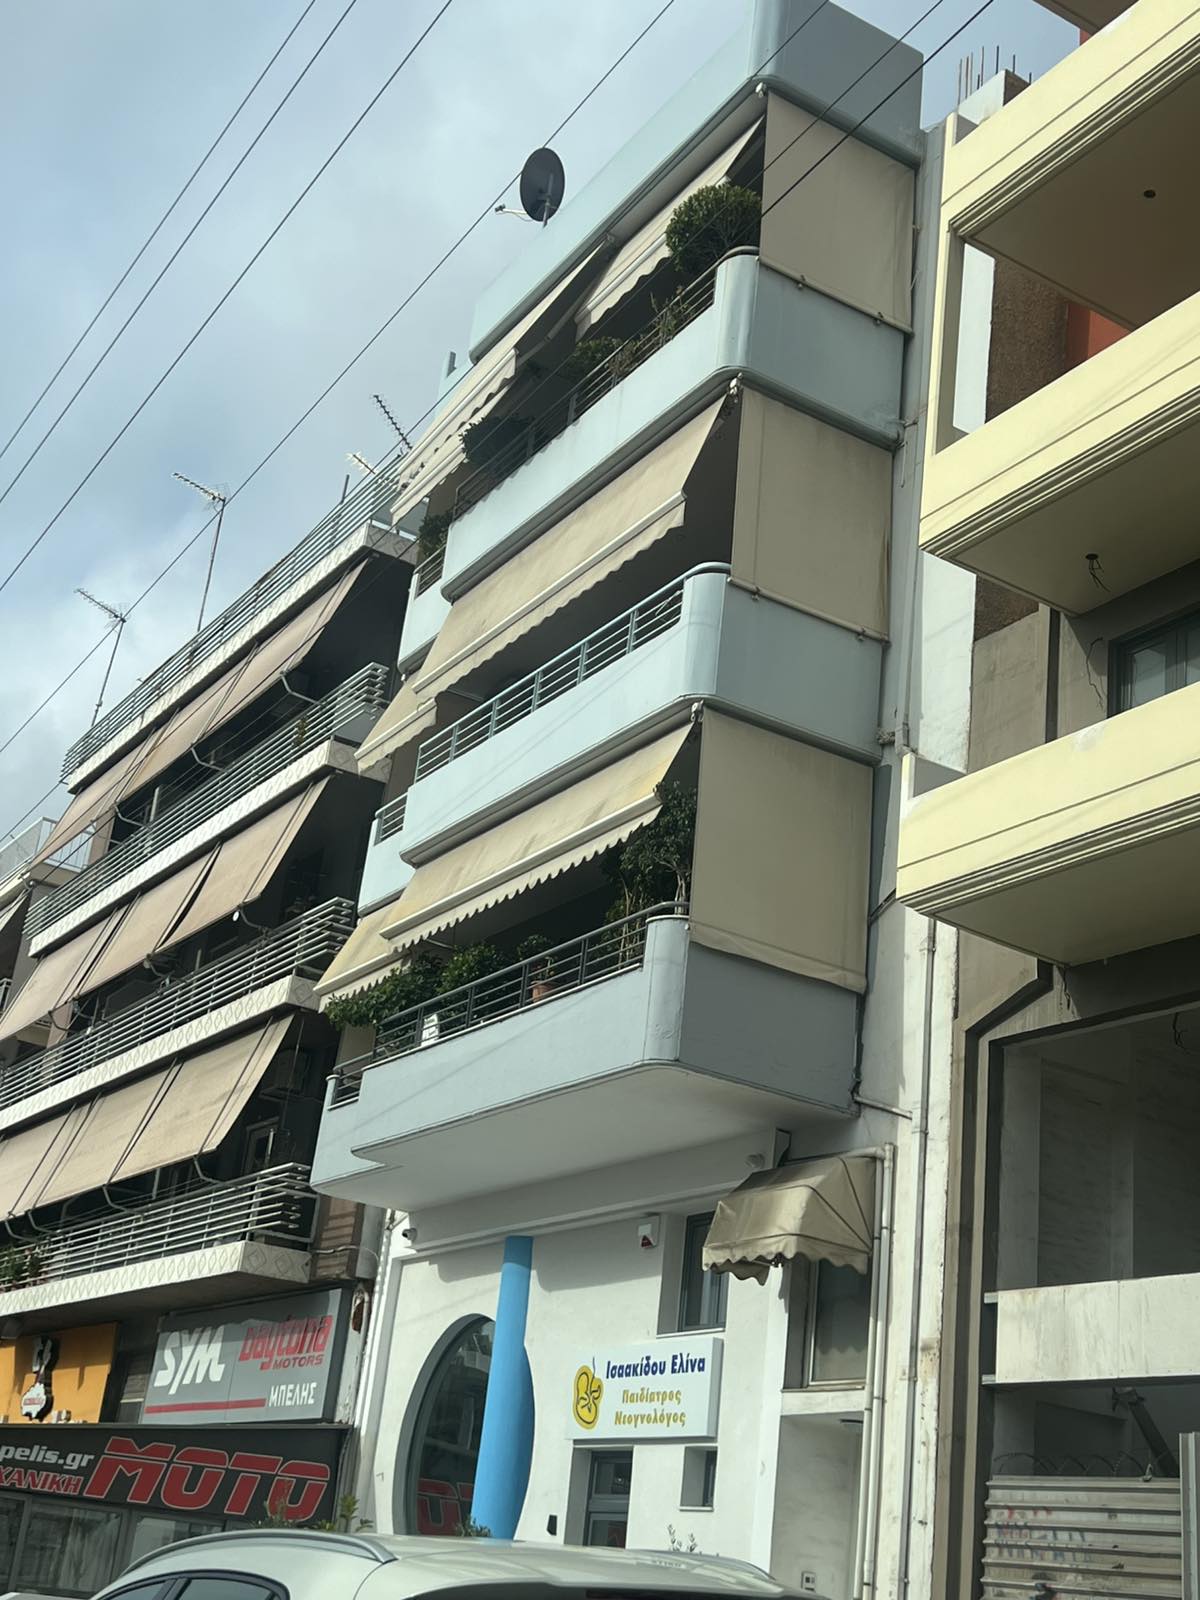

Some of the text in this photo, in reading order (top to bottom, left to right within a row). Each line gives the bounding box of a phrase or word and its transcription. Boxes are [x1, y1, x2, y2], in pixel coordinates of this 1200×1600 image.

[154, 1325, 226, 1395] SYM
[272, 1353, 324, 1370] MOTORS
[606, 1352, 706, 1379] Ισαακίδου Ελίνα
[268, 1382, 317, 1407] ΜΠΕΛΗΣ
[622, 1387, 682, 1406] Παιδίατρος
[614, 1408, 686, 1428] Νεογνολόγος
